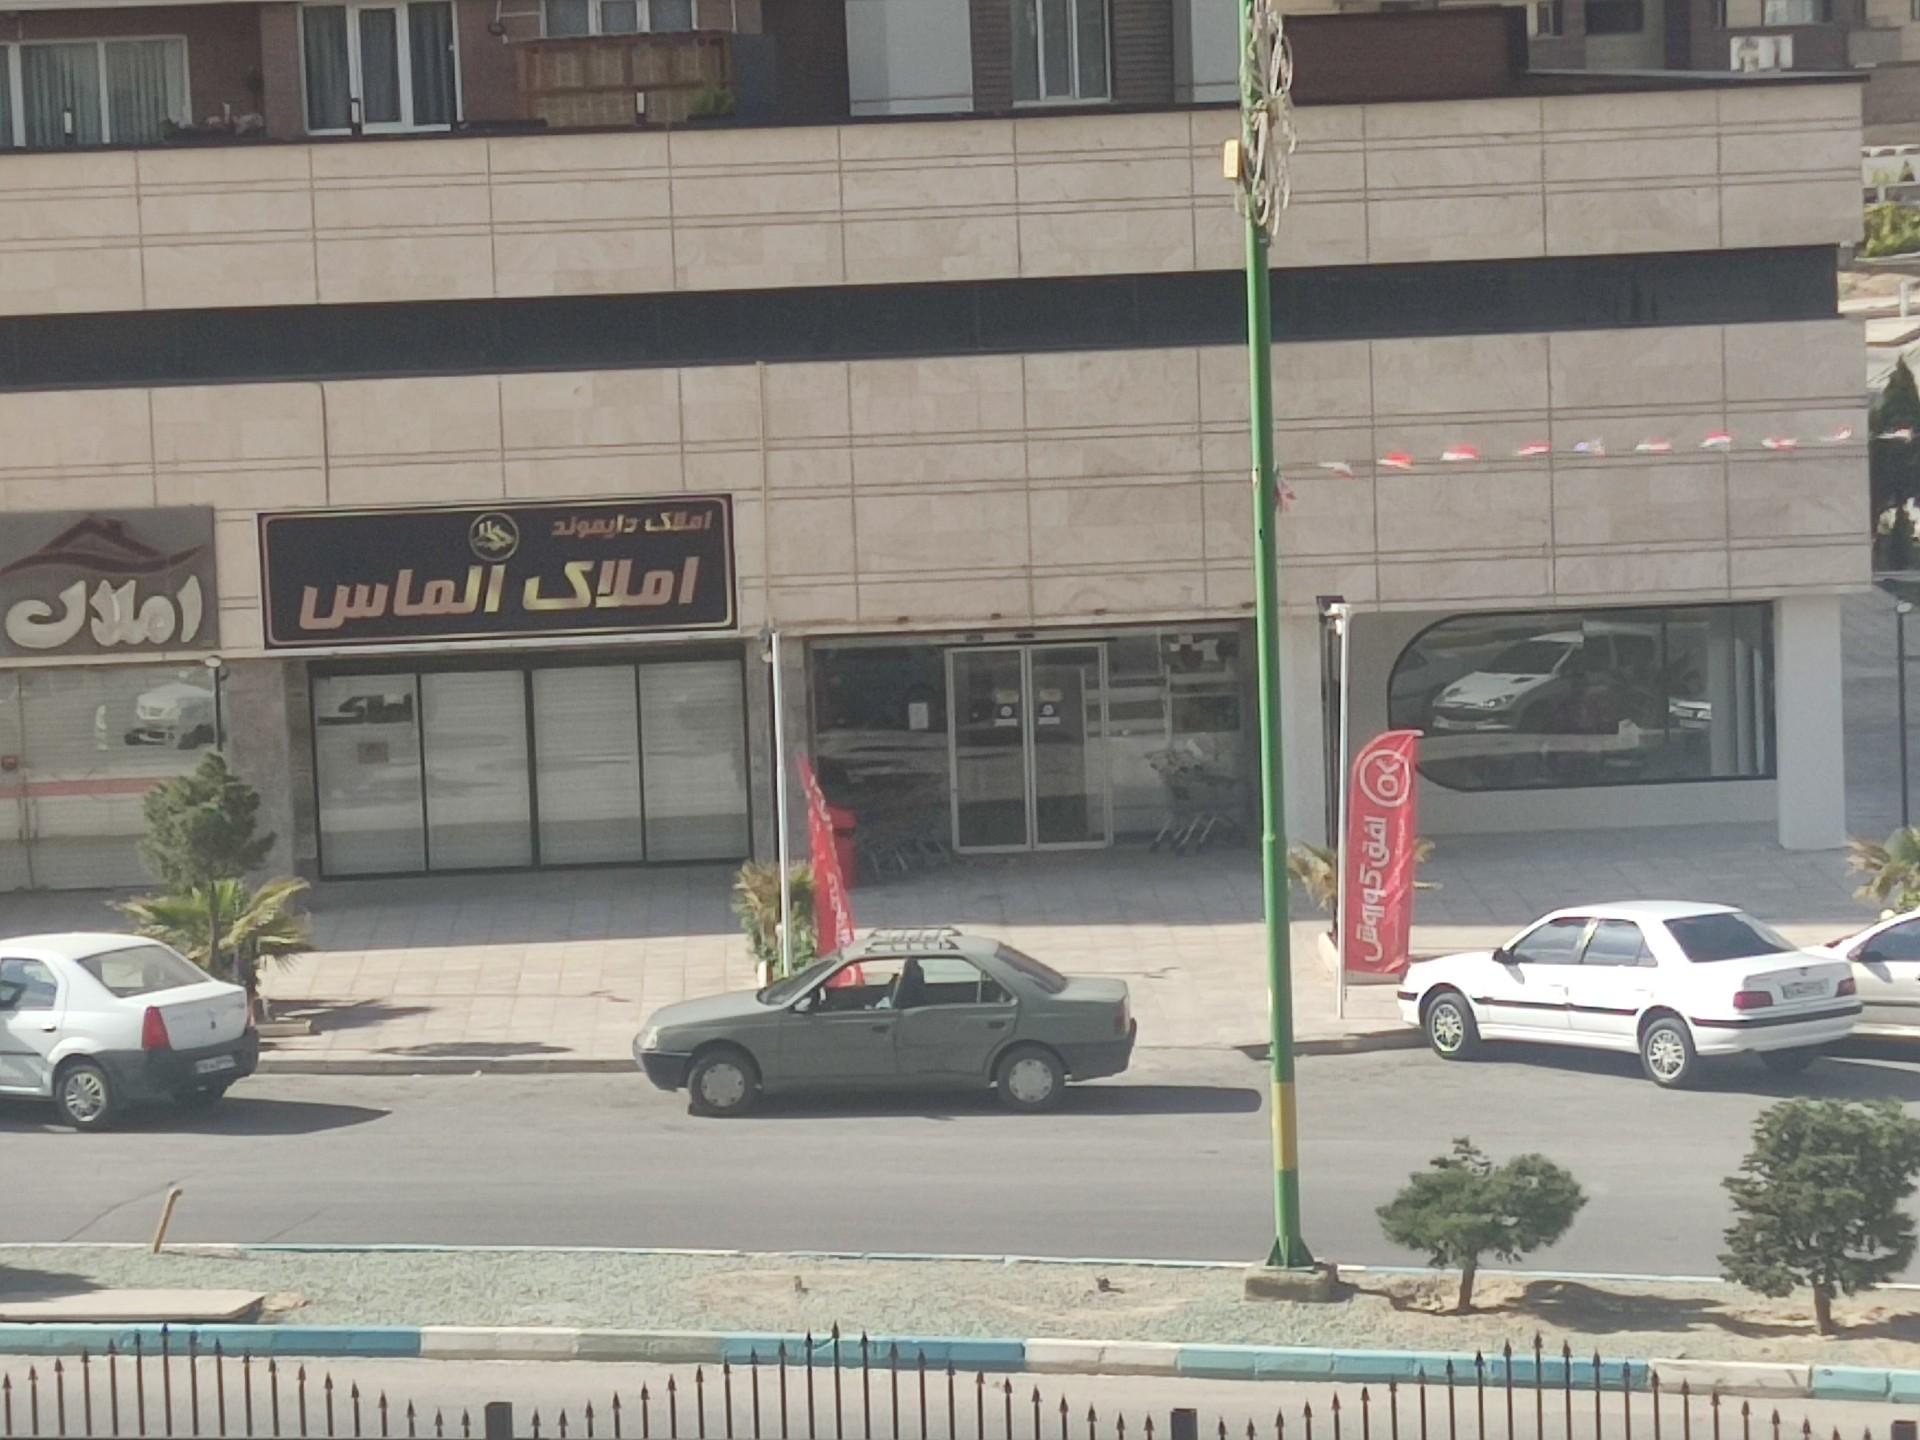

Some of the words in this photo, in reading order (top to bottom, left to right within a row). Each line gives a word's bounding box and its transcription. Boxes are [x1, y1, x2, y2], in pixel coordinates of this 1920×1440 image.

[551, 514, 639, 539] دایموند
[644, 510, 713, 532] املاک
[299, 562, 506, 630] الماس
[522, 555, 700, 612] املاک
[1363, 815, 1390, 868] افق
[1355, 864, 1386, 963] کوروش
